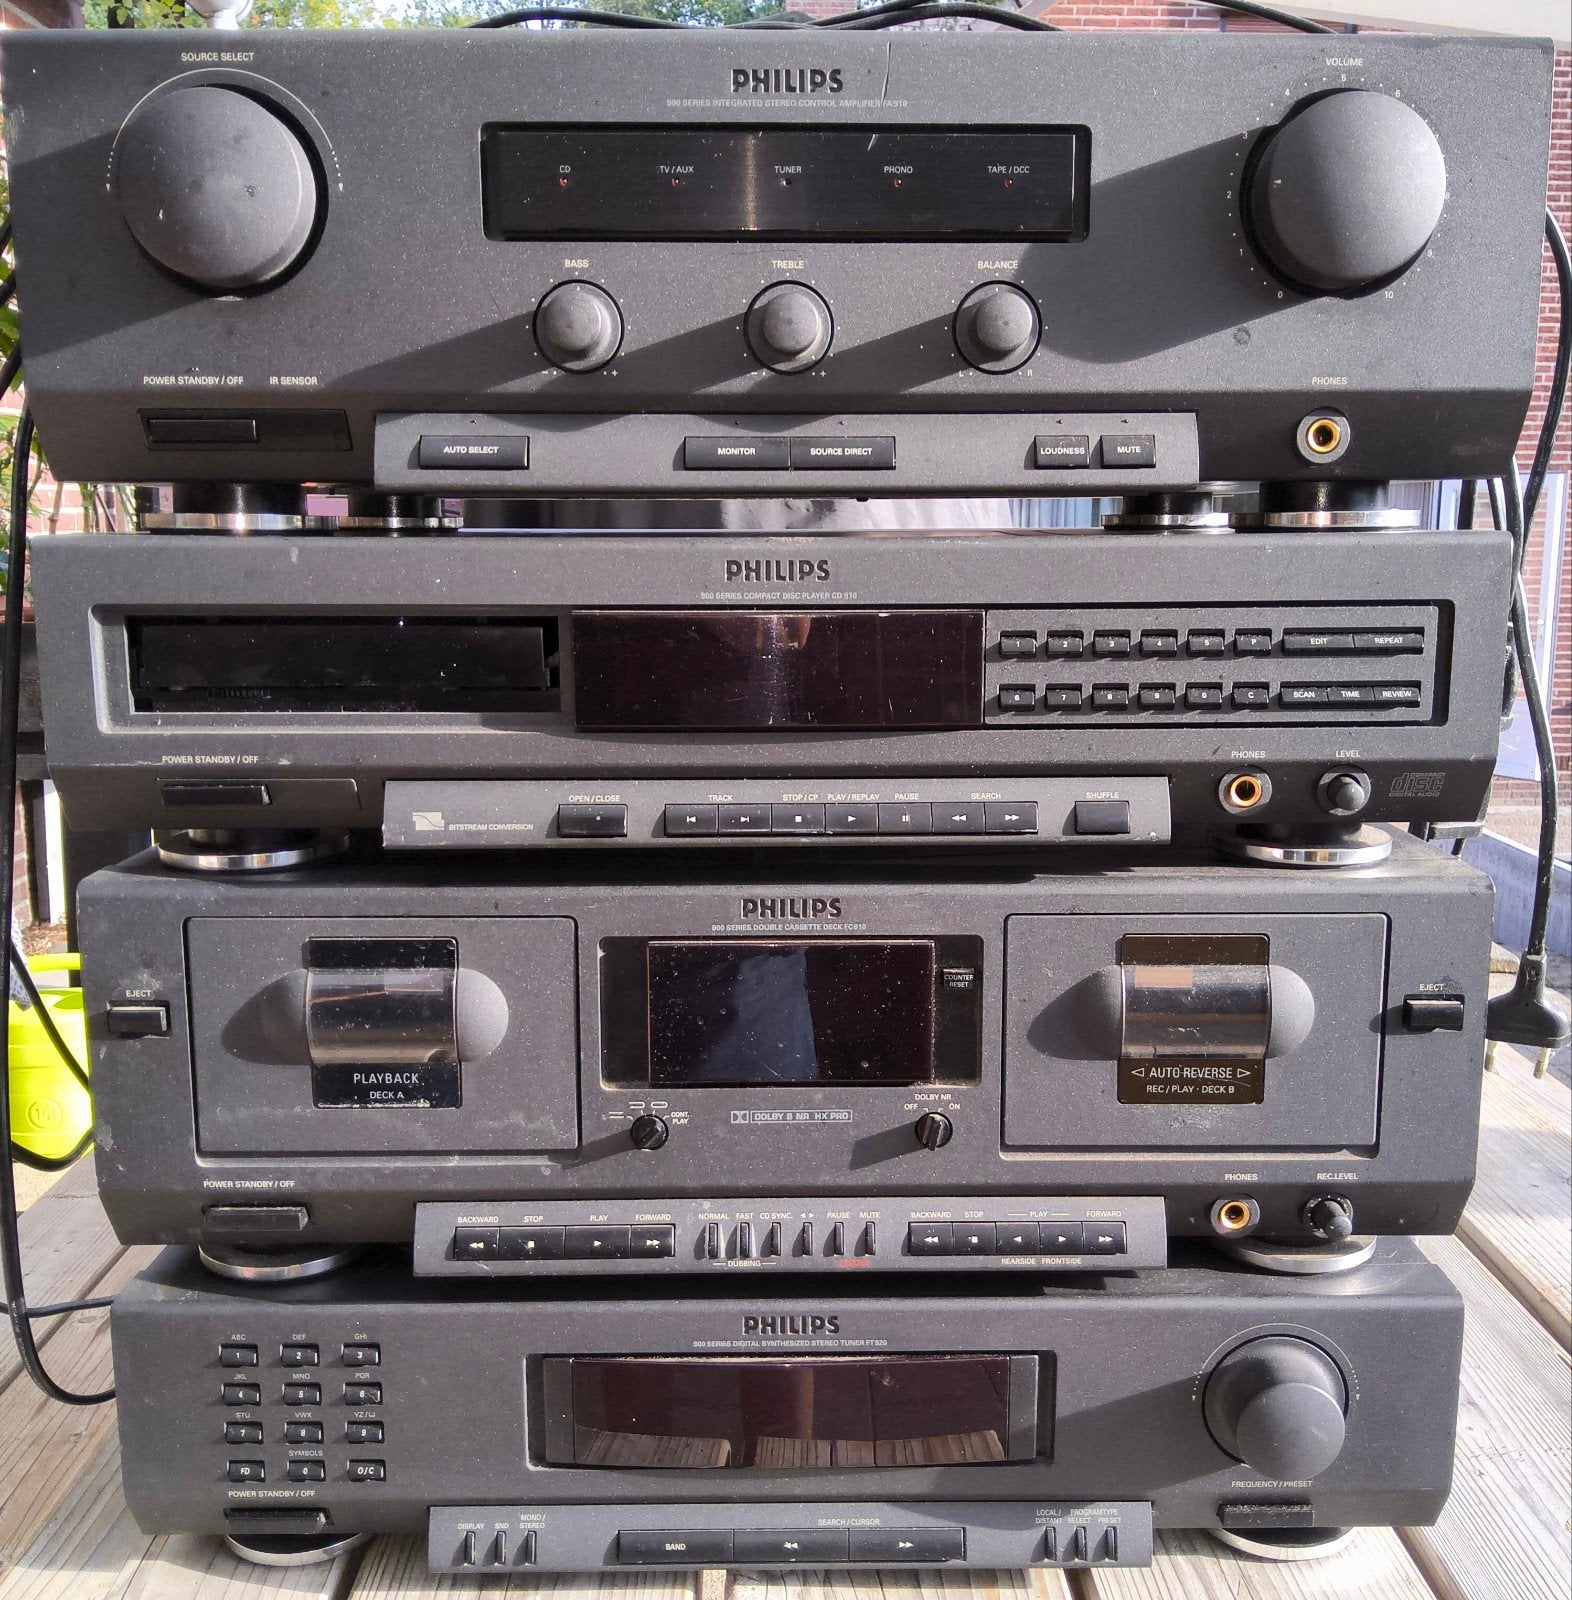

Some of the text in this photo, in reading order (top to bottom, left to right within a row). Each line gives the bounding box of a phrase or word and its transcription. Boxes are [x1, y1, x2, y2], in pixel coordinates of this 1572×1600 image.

[180, 52, 255, 62] SOURCE SELECT
[1325, 57, 1364, 67] VOLUME
[731, 68, 844, 93] PHILIPS
[666, 99, 681, 107] 900
[682, 99, 711, 107] SERIES
[712, 99, 763, 107] INTEGRATED
[764, 99, 797, 107] STEREO
[798, 99, 837, 107] CONTROL
[838, 99, 881, 108] AMPLIFIER
[559, 165, 571, 173] CD
[659, 165, 694, 173] TV AUX
[774, 166, 802, 174] TUNER
[884, 166, 914, 174] PHONO
[987, 166, 1030, 174] TAPE DCC
[564, 259, 589, 269] BASS
[771, 260, 805, 270] TREBLE
[977, 260, 1019, 270] BALANCE
[143, 376, 244, 385] POWER STANDBY OFF
[269, 377, 318, 386] IR SENSOR
[1311, 376, 1348, 385] PHONES
[443, 446, 499, 454] AUTO SELECT
[717, 447, 756, 456] MONITOR
[810, 447, 873, 456] SOURCE DIRECT
[1040, 446, 1085, 456] LOUDNESS
[1116, 445, 1142, 454] MUTE
[725, 559, 831, 582] PHILIPS
[1382, 690, 1412, 698] REVIEW
[1231, 750, 1266, 759] PHONES
[1335, 750, 1361, 758] LEVEL
[161, 755, 259, 764] POWER STANDBY OFF
[1390, 772, 1445, 792] disc
[568, 795, 621, 803] OPEN CLOSE
[708, 794, 733, 802] TRACK
[782, 794, 819, 802] STOP CP
[851, 793, 880, 801] REPLAY
[971, 792, 1002, 800] SEARCH
[1085, 791, 1119, 799] SHUFFLE
[488, 823, 534, 831] CONVERSION
[741, 898, 843, 919] PHILIPS
[784, 923, 823, 931] CASSETTE
[1419, 983, 1445, 991] EJECT
[126, 989, 152, 998] EJECT
[1149, 1067, 1233, 1078] AUTO REVERSE
[353, 1073, 419, 1084] PLAYBACK
[1146, 1085, 1235, 1094] REC PLAY DECK B
[369, 1091, 405, 1099] DECK A
[914, 1093, 940, 1101] DOLBY
[754, 1113, 784, 1121] DOLBY
[795, 1112, 810, 1120] NR
[814, 1112, 828, 1120] HX
[830, 1112, 849, 1120] PRO
[1224, 1173, 1258, 1181] PHONES
[1316, 1172, 1359, 1180] REC.LEVEL
[203, 1180, 295, 1188] POWER STANDBY OFF
[635, 1214, 672, 1222] FORWARD
[911, 1211, 952, 1219] BACKWARD
[1086, 1210, 1122, 1218] FORWARD
[457, 1216, 499, 1224] BACKWARD
[1041, 1257, 1082, 1265] FRONTSIDE
[742, 1315, 841, 1336] PHILIPS
[240, 1467, 250, 1475] FD
[1231, 1480, 1313, 1488] FREQUENCY PRESET
[228, 1490, 257, 1498] POWER
[258, 1490, 295, 1498] STANDBY
[1070, 1508, 1119, 1516] PROGRAMTYPE
[817, 1518, 880, 1526] SEARCH CURSOR
[665, 1543, 686, 1551] BAND
